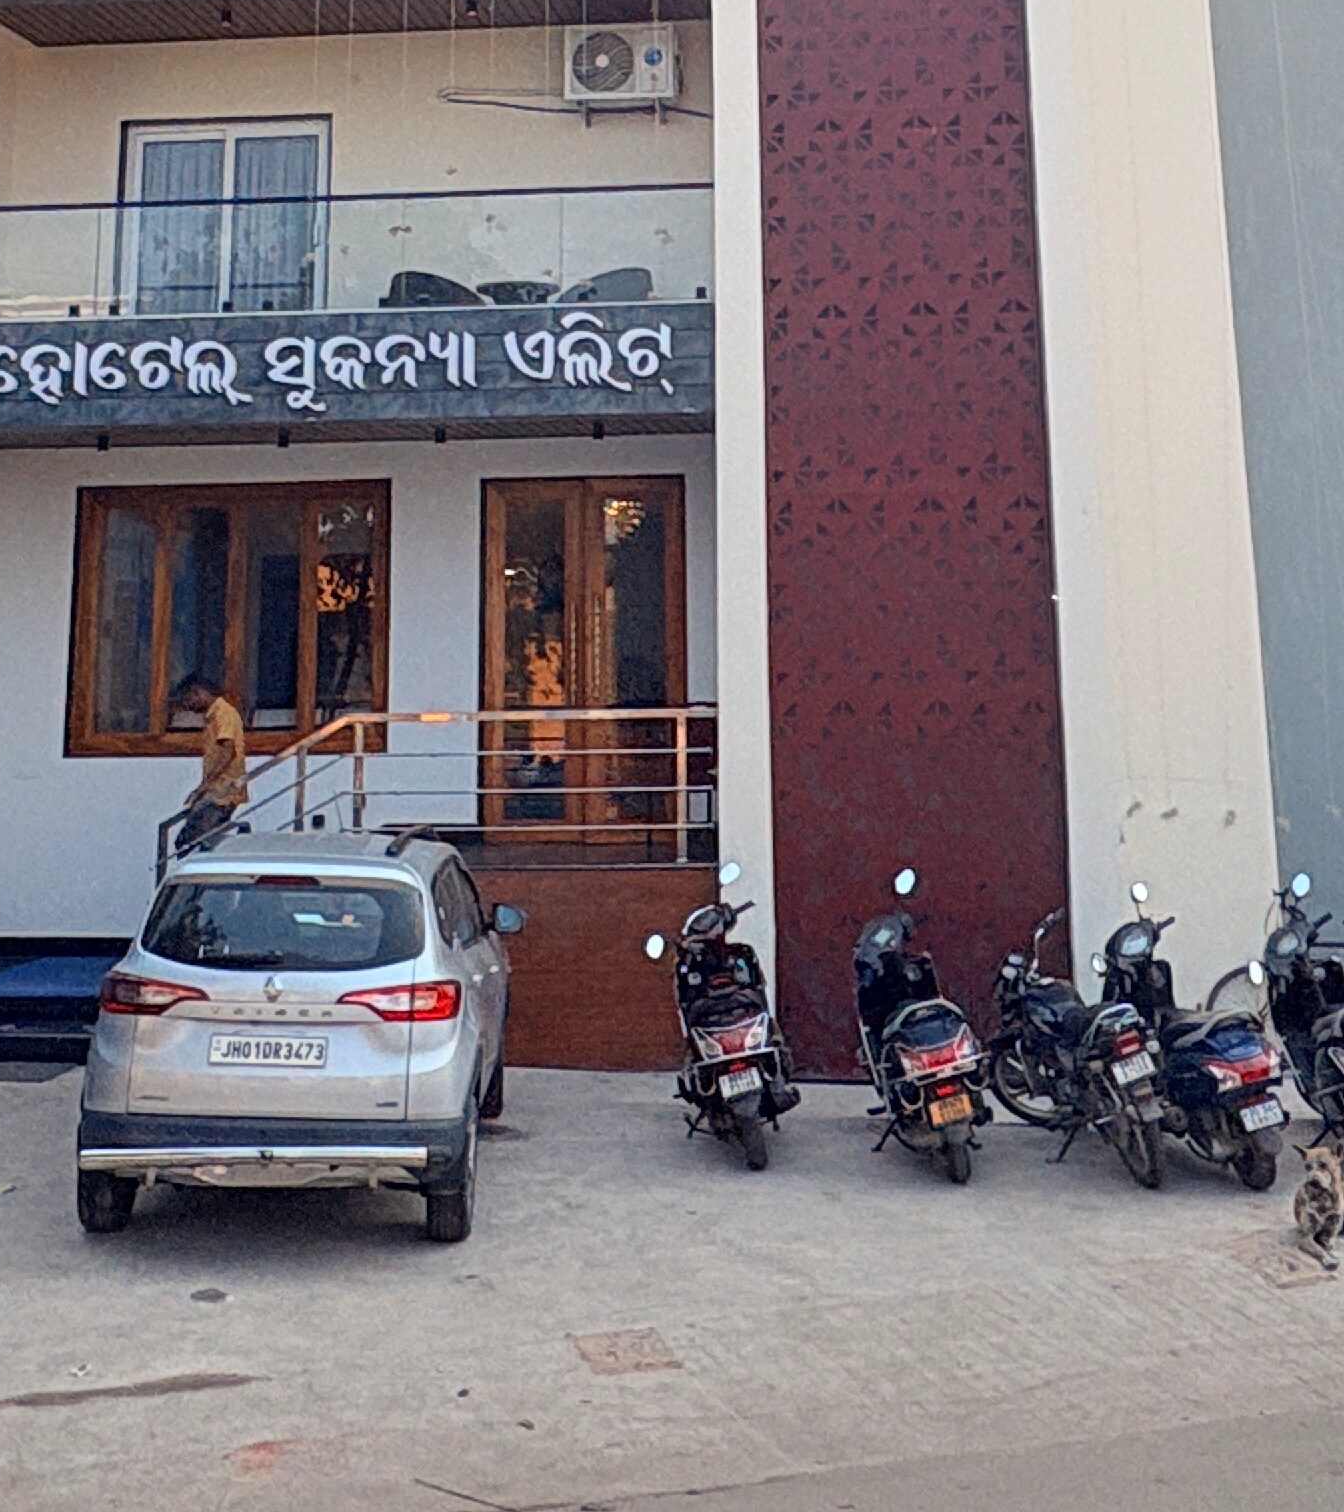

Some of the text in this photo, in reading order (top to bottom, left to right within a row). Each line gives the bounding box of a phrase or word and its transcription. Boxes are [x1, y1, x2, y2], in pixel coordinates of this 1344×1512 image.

[264, 331, 478, 411] ସୁକନ୍ୟା
[503, 312, 674, 395] ଏଲିଟ୍
[220, 1039, 325, 1061] JH01DR3473
